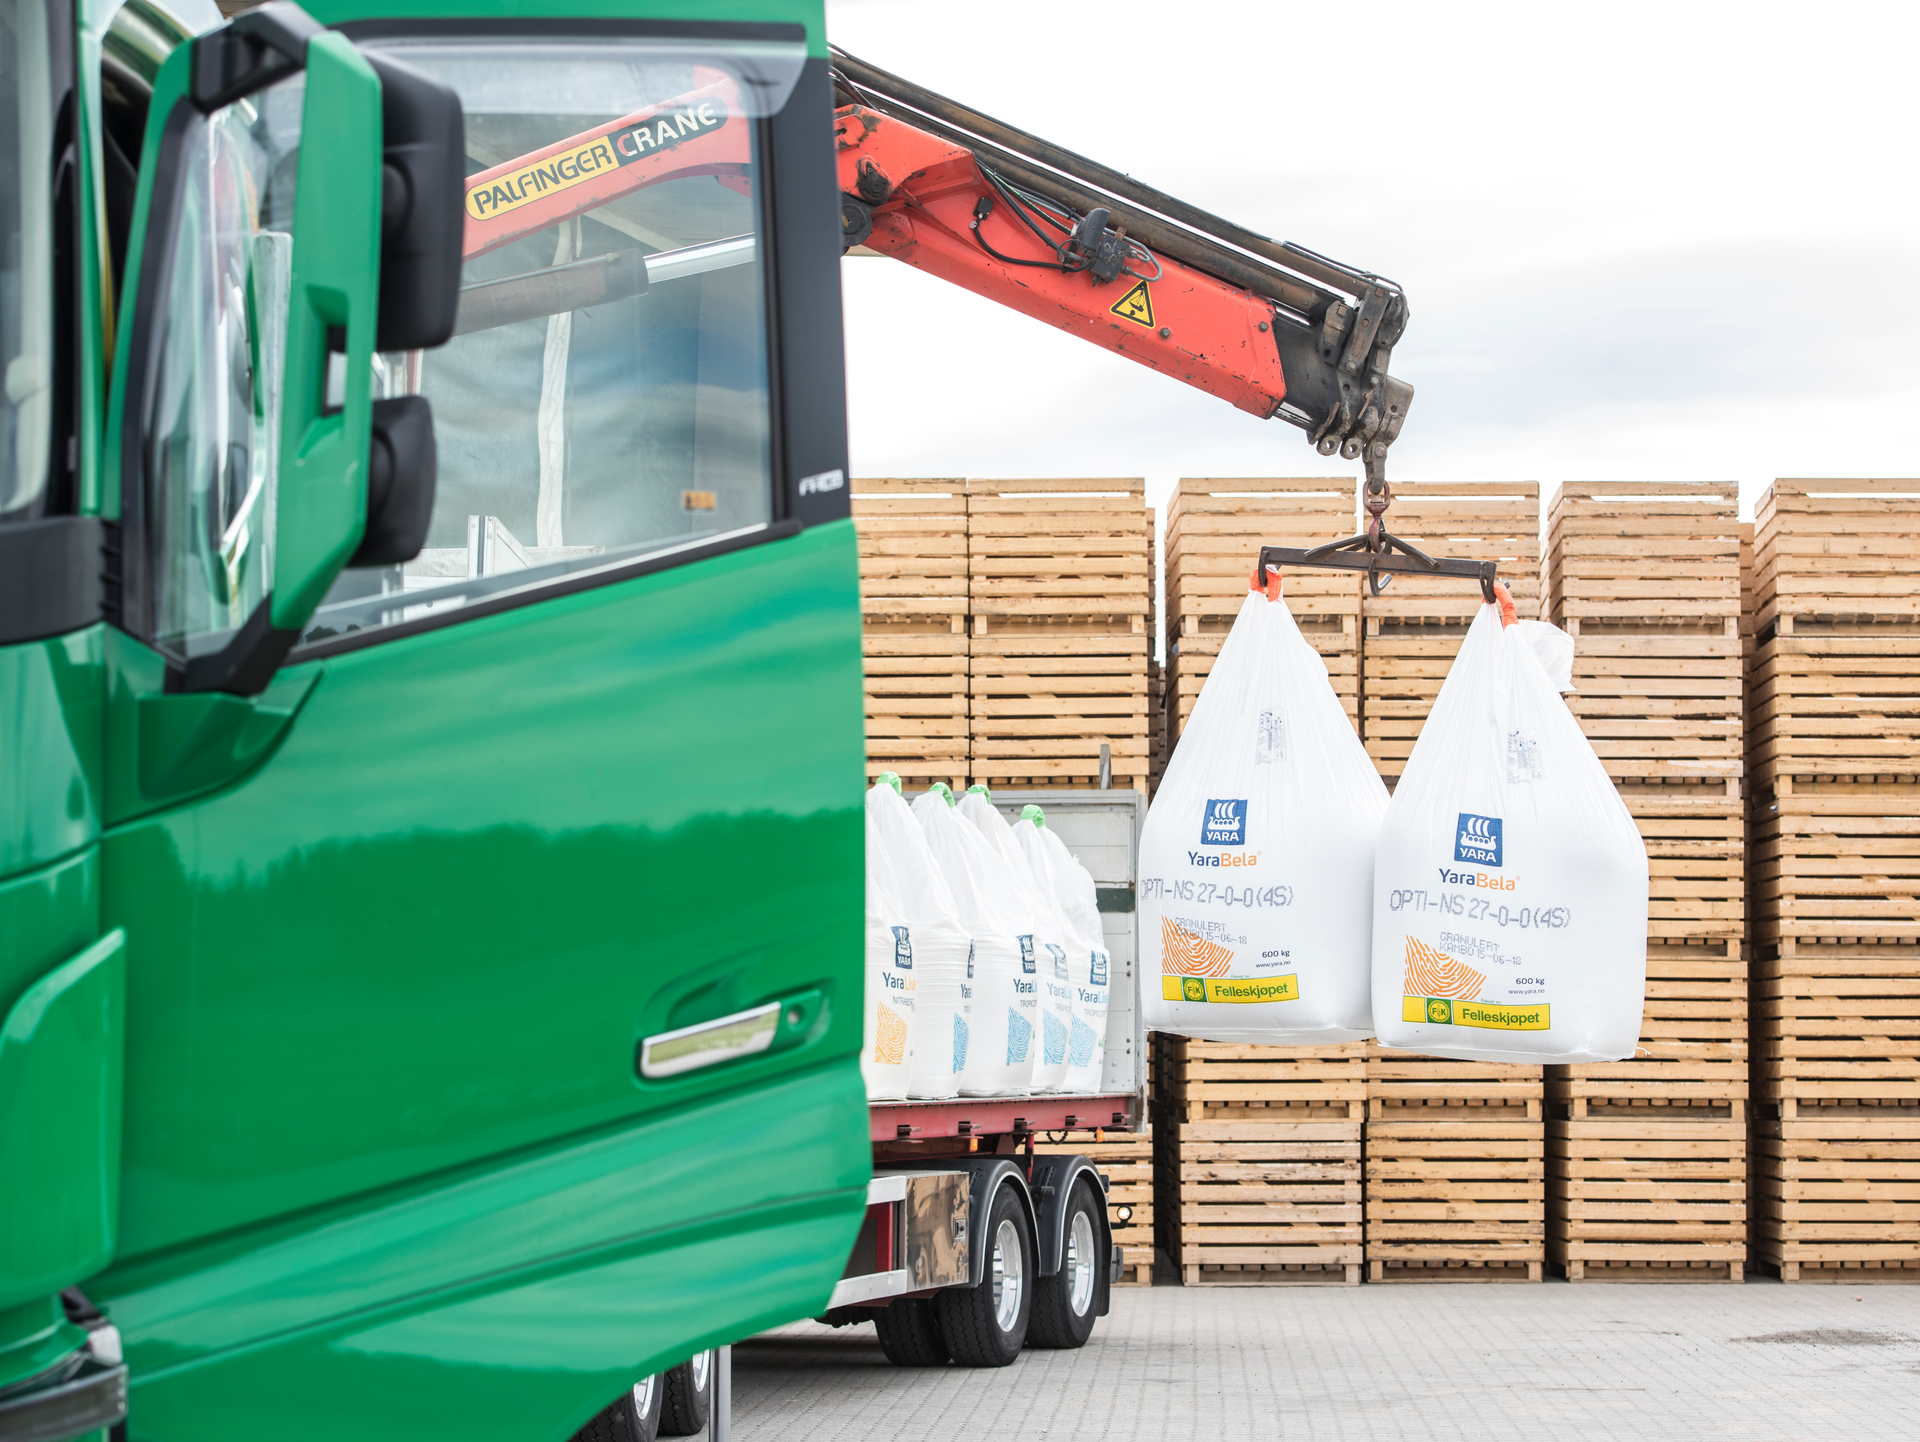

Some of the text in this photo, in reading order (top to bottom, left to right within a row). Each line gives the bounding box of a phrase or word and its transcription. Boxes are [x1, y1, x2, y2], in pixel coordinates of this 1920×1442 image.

[473, 102, 718, 214] PALFINGER CRANE
[1206, 831, 1240, 842] YARA
[1460, 847, 1497, 862] YARA
[1140, 878, 1195, 901] OPTI-NS
[1390, 889, 1465, 916] OPTI-NS
[1175, 917, 1227, 932] GRANULERT
[1206, 931, 1247, 944] 15-06-18
[1440, 931, 1500, 952] GRANULERT
[898, 955, 912, 966] YARA
[1262, 950, 1279, 958] 600
[1439, 942, 1522, 965] KAMBO 15-06-18
[1255, 960, 1291, 968] www.yara.no
[1516, 977, 1545, 985] 600 kg
[1215, 983, 1288, 998] Felleskjøpet
[1462, 1008, 1539, 1026] Felleskjøpet
